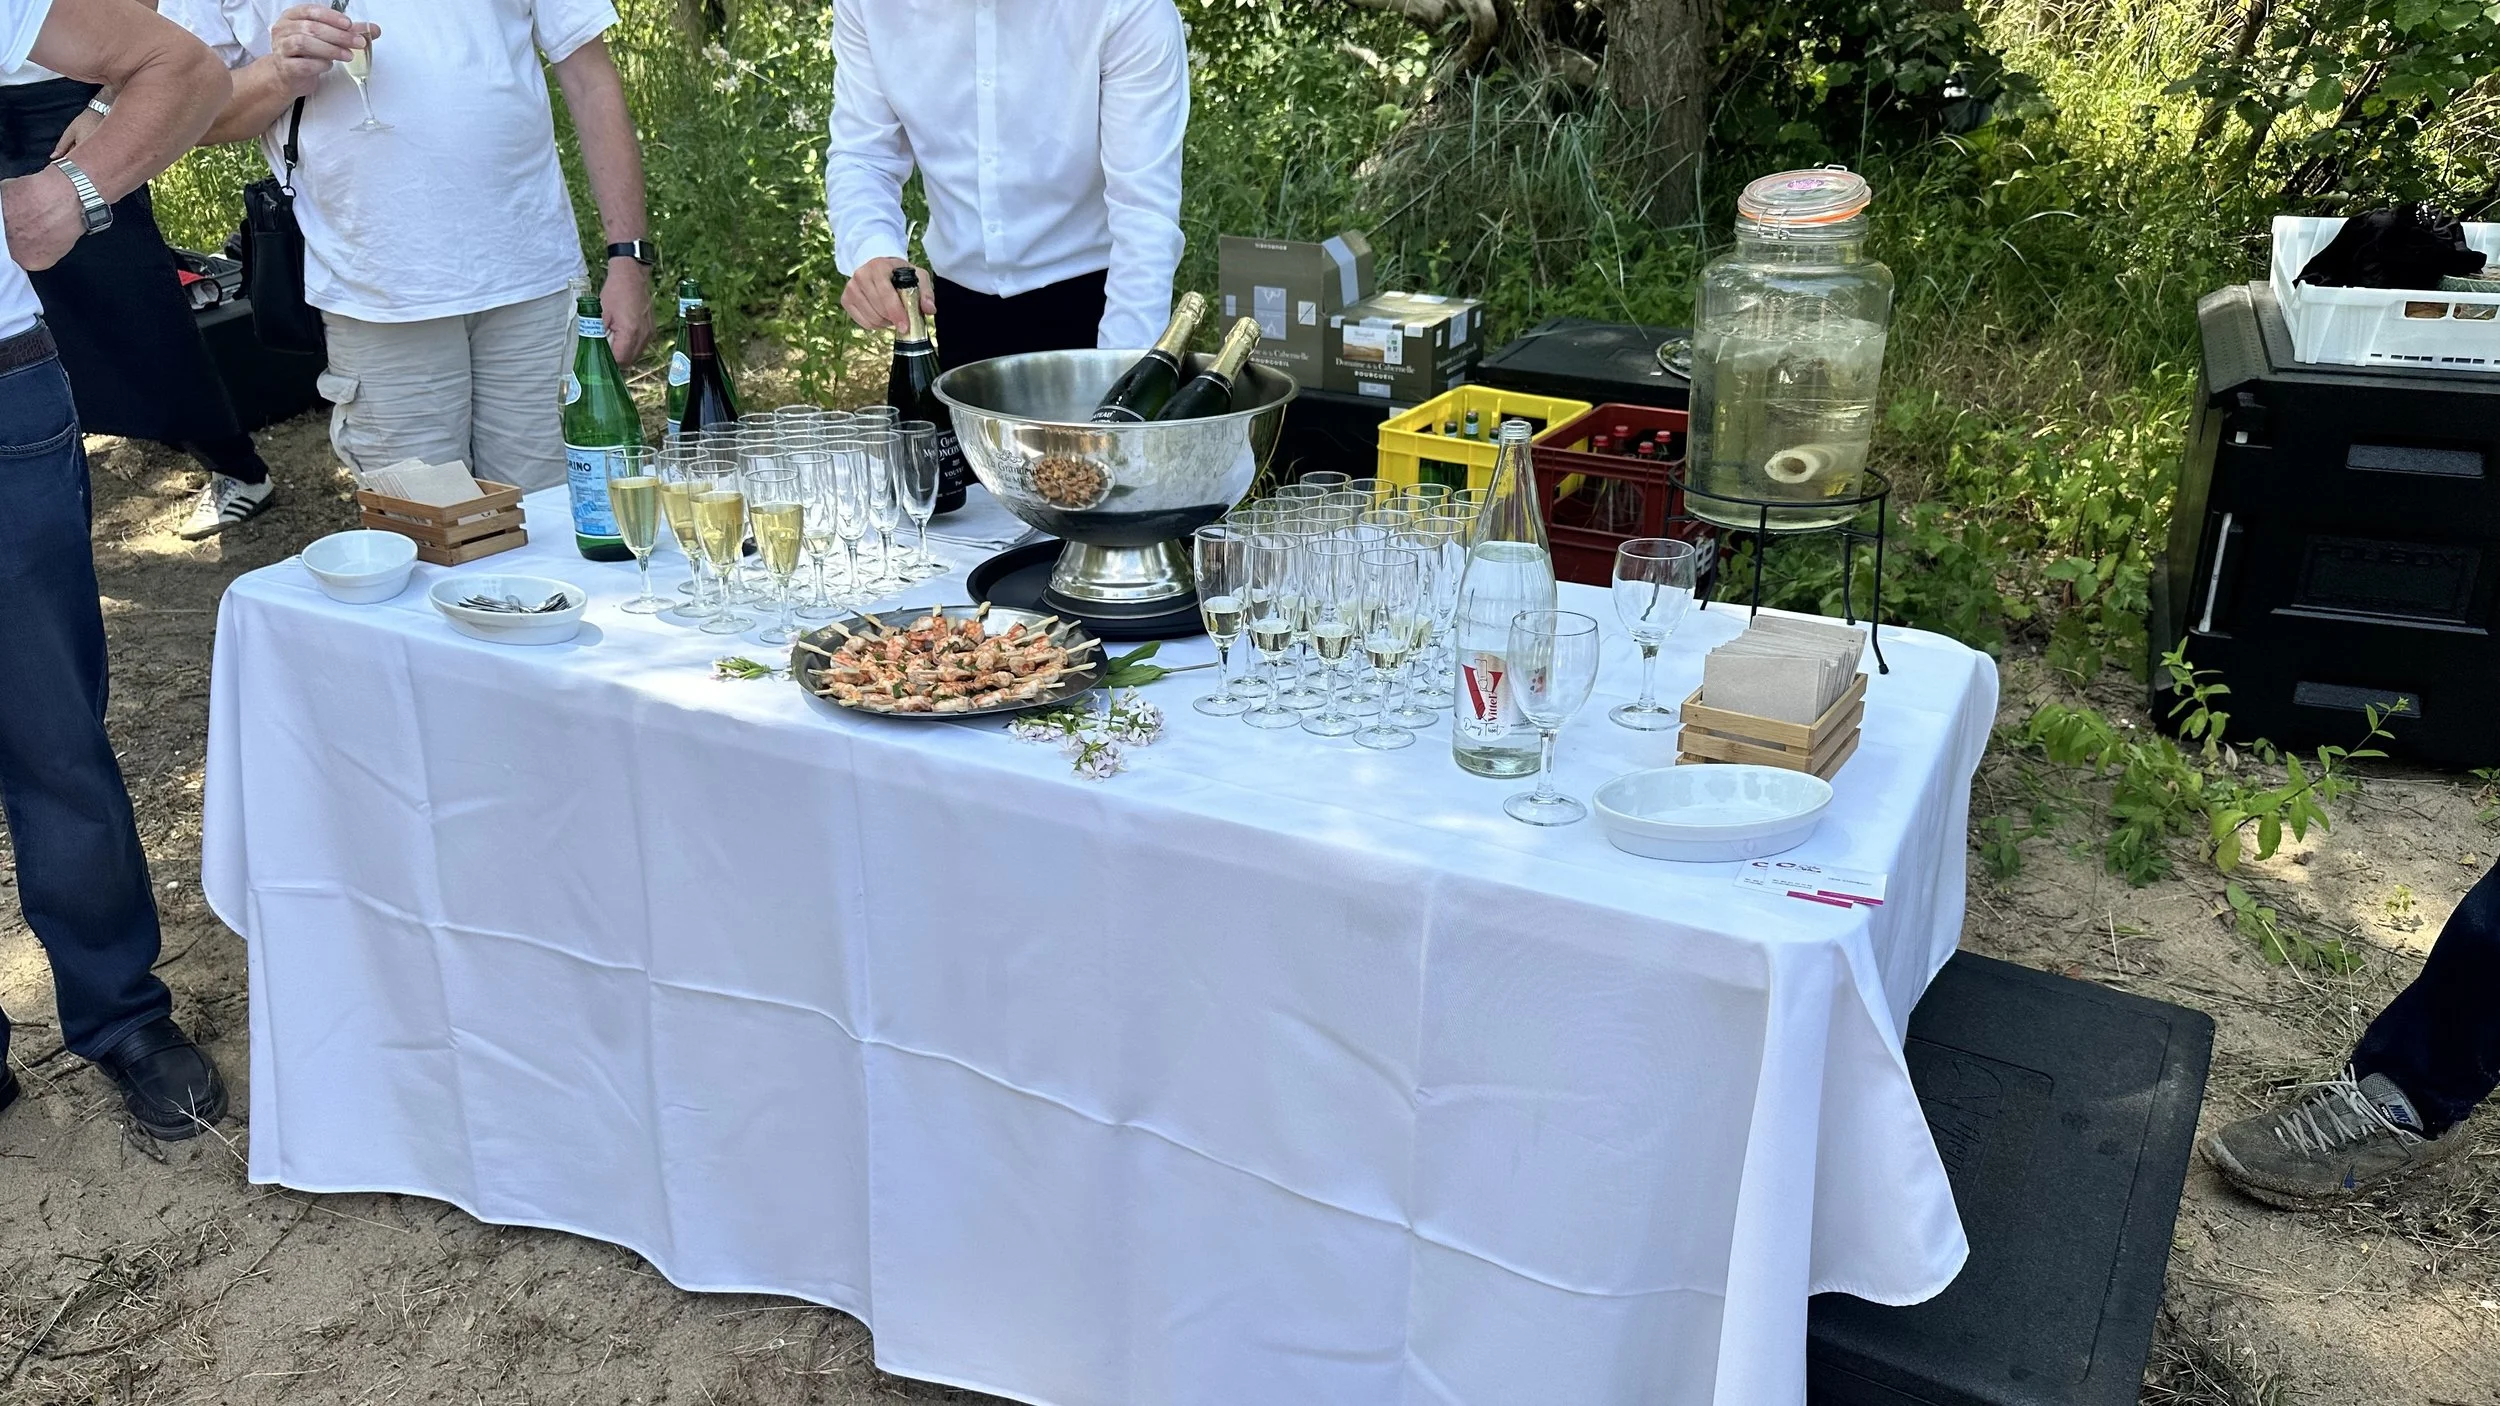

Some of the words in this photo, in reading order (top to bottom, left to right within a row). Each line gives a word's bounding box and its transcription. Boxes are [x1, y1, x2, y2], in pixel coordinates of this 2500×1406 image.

[1354, 370, 1395, 381] BOURGUEIL
[568, 460, 591, 472] RINO
[2389, 1105, 2412, 1123] NIKE
